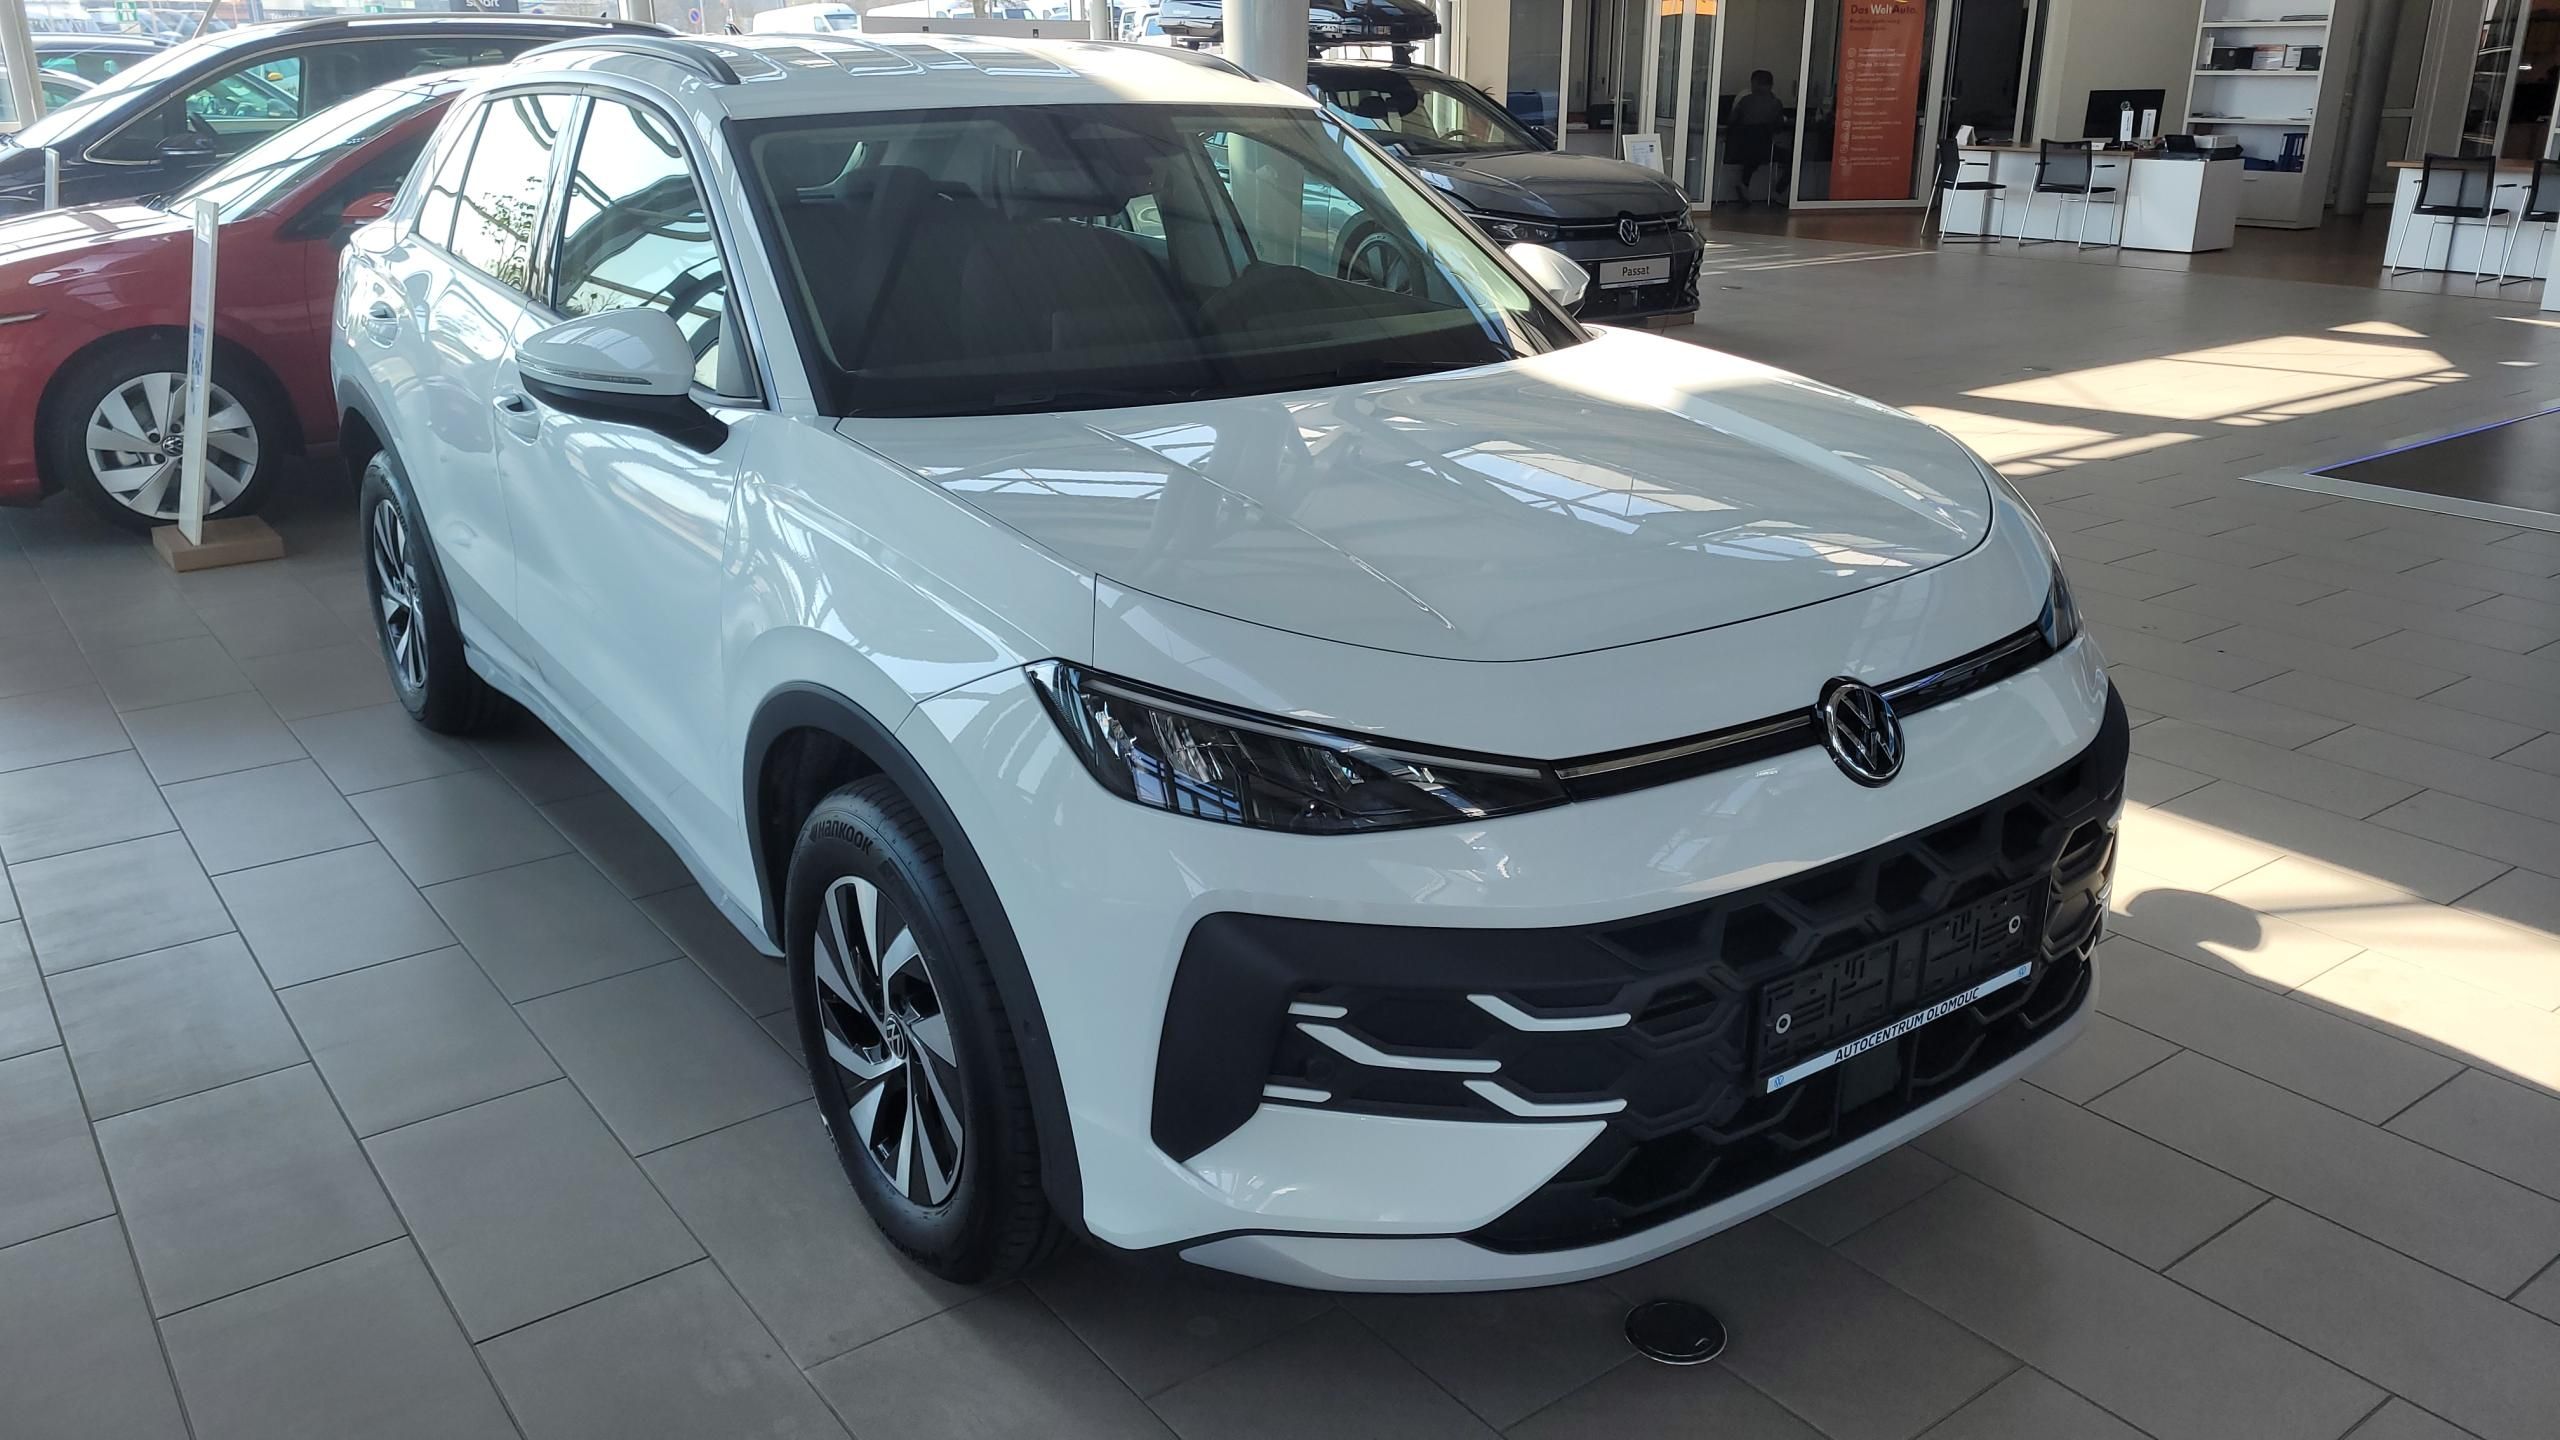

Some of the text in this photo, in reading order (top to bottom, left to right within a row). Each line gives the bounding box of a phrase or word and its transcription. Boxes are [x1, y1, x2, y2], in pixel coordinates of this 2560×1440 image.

[1622, 266, 1650, 277] Passat
[1834, 987, 1980, 1063] AUTOCENTRUM OLOMOUC
